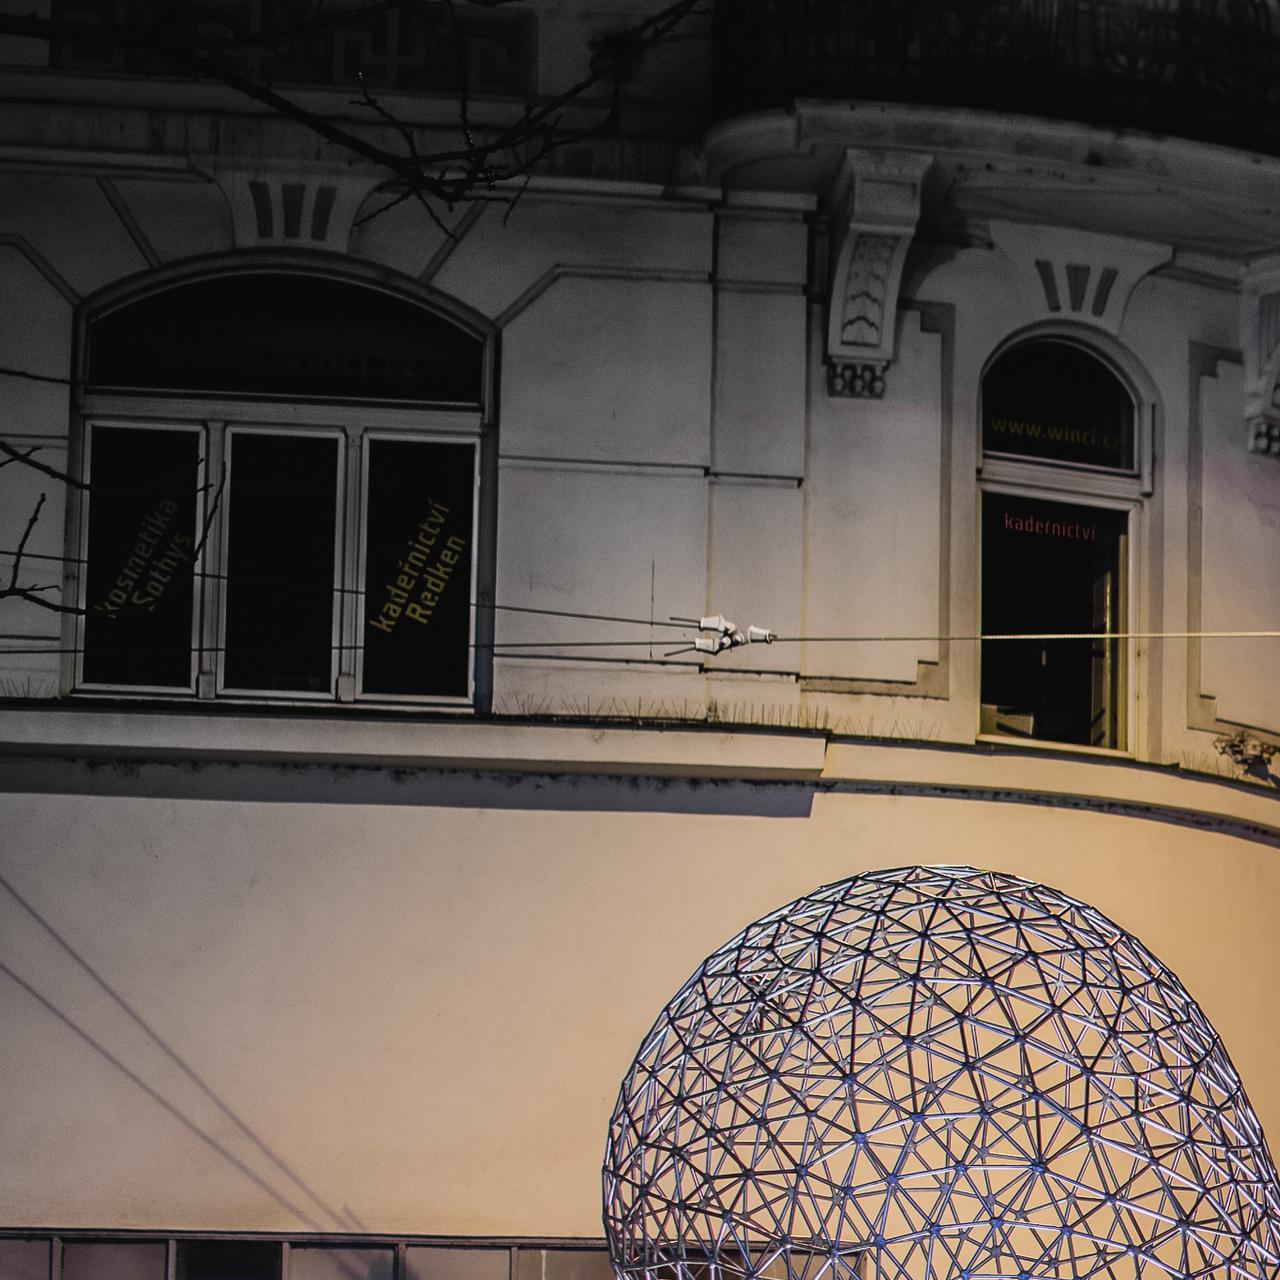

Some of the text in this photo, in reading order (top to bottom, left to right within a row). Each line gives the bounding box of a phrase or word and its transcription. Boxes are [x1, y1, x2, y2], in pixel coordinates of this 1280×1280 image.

[991, 416, 1121, 449] www.winci.cz
[94, 497, 180, 619] kosmetika
[368, 497, 451, 635] kadeřnictví
[1003, 511, 1097, 542] kadeřnictví
[132, 531, 192, 614] Sothys
[404, 535, 466, 625] Redken
